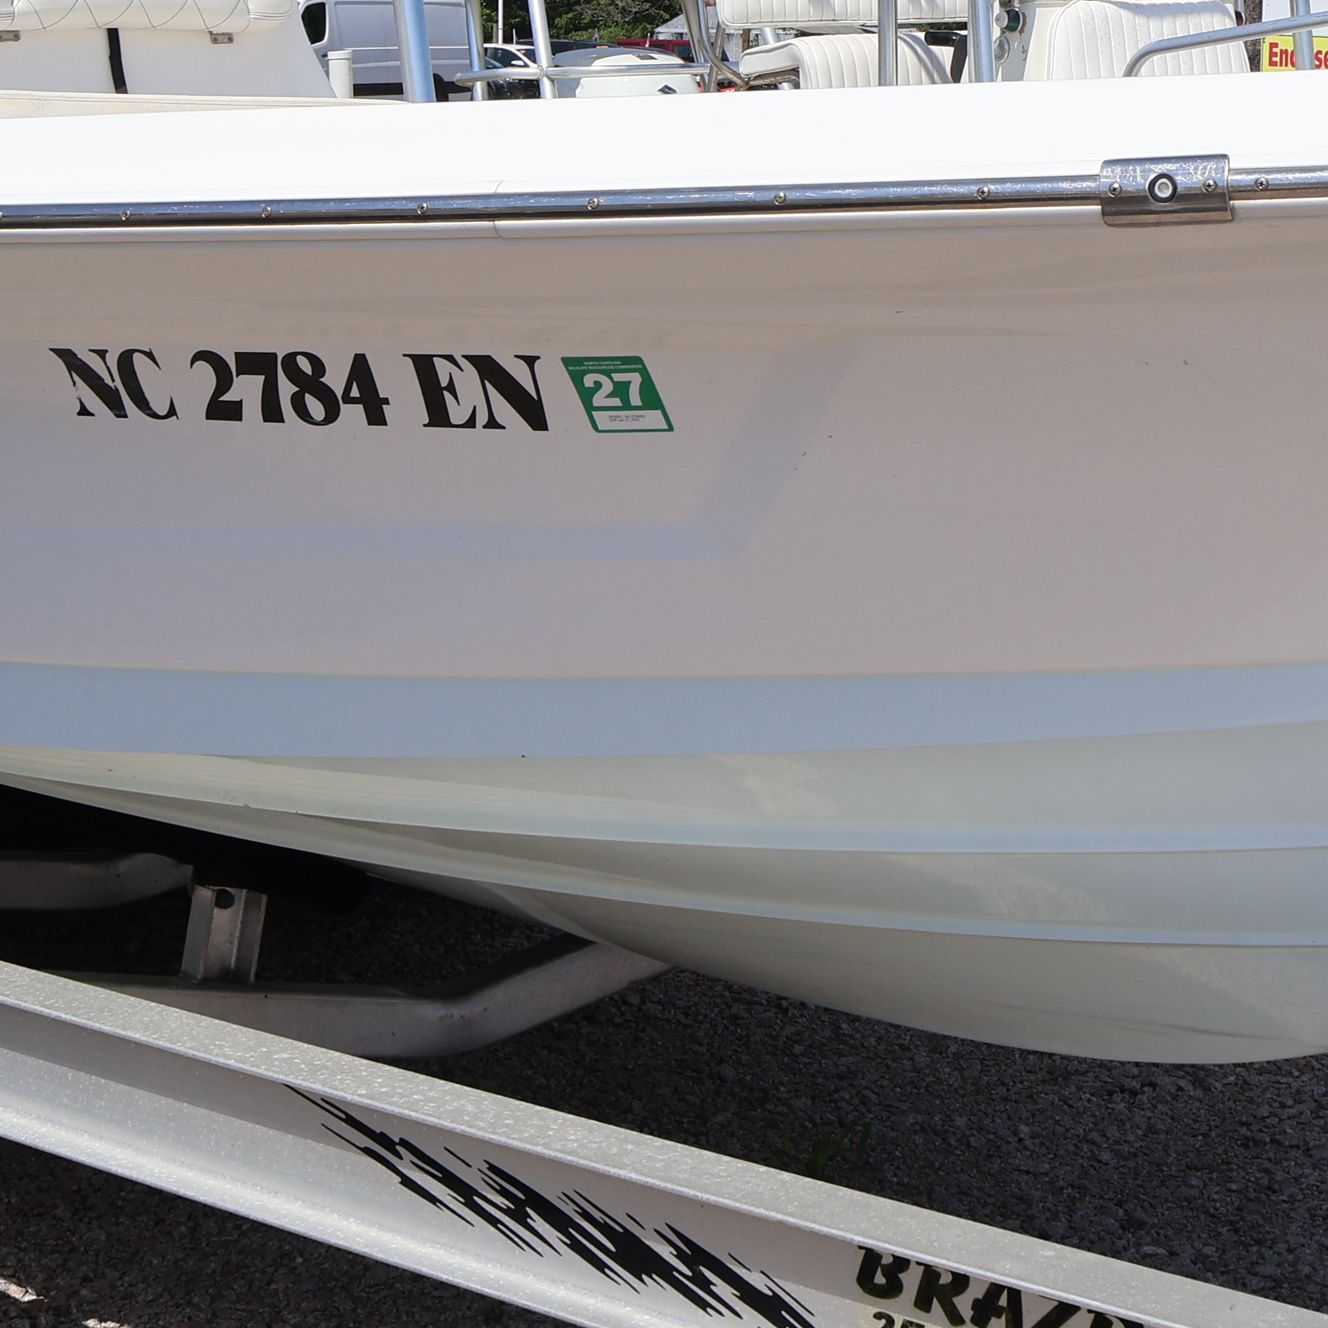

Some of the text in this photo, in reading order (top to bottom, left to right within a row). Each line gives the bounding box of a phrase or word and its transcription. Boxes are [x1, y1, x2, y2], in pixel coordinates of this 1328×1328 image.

[48, 348, 550, 432] NC 2784 EN
[583, 372, 643, 407] 27
